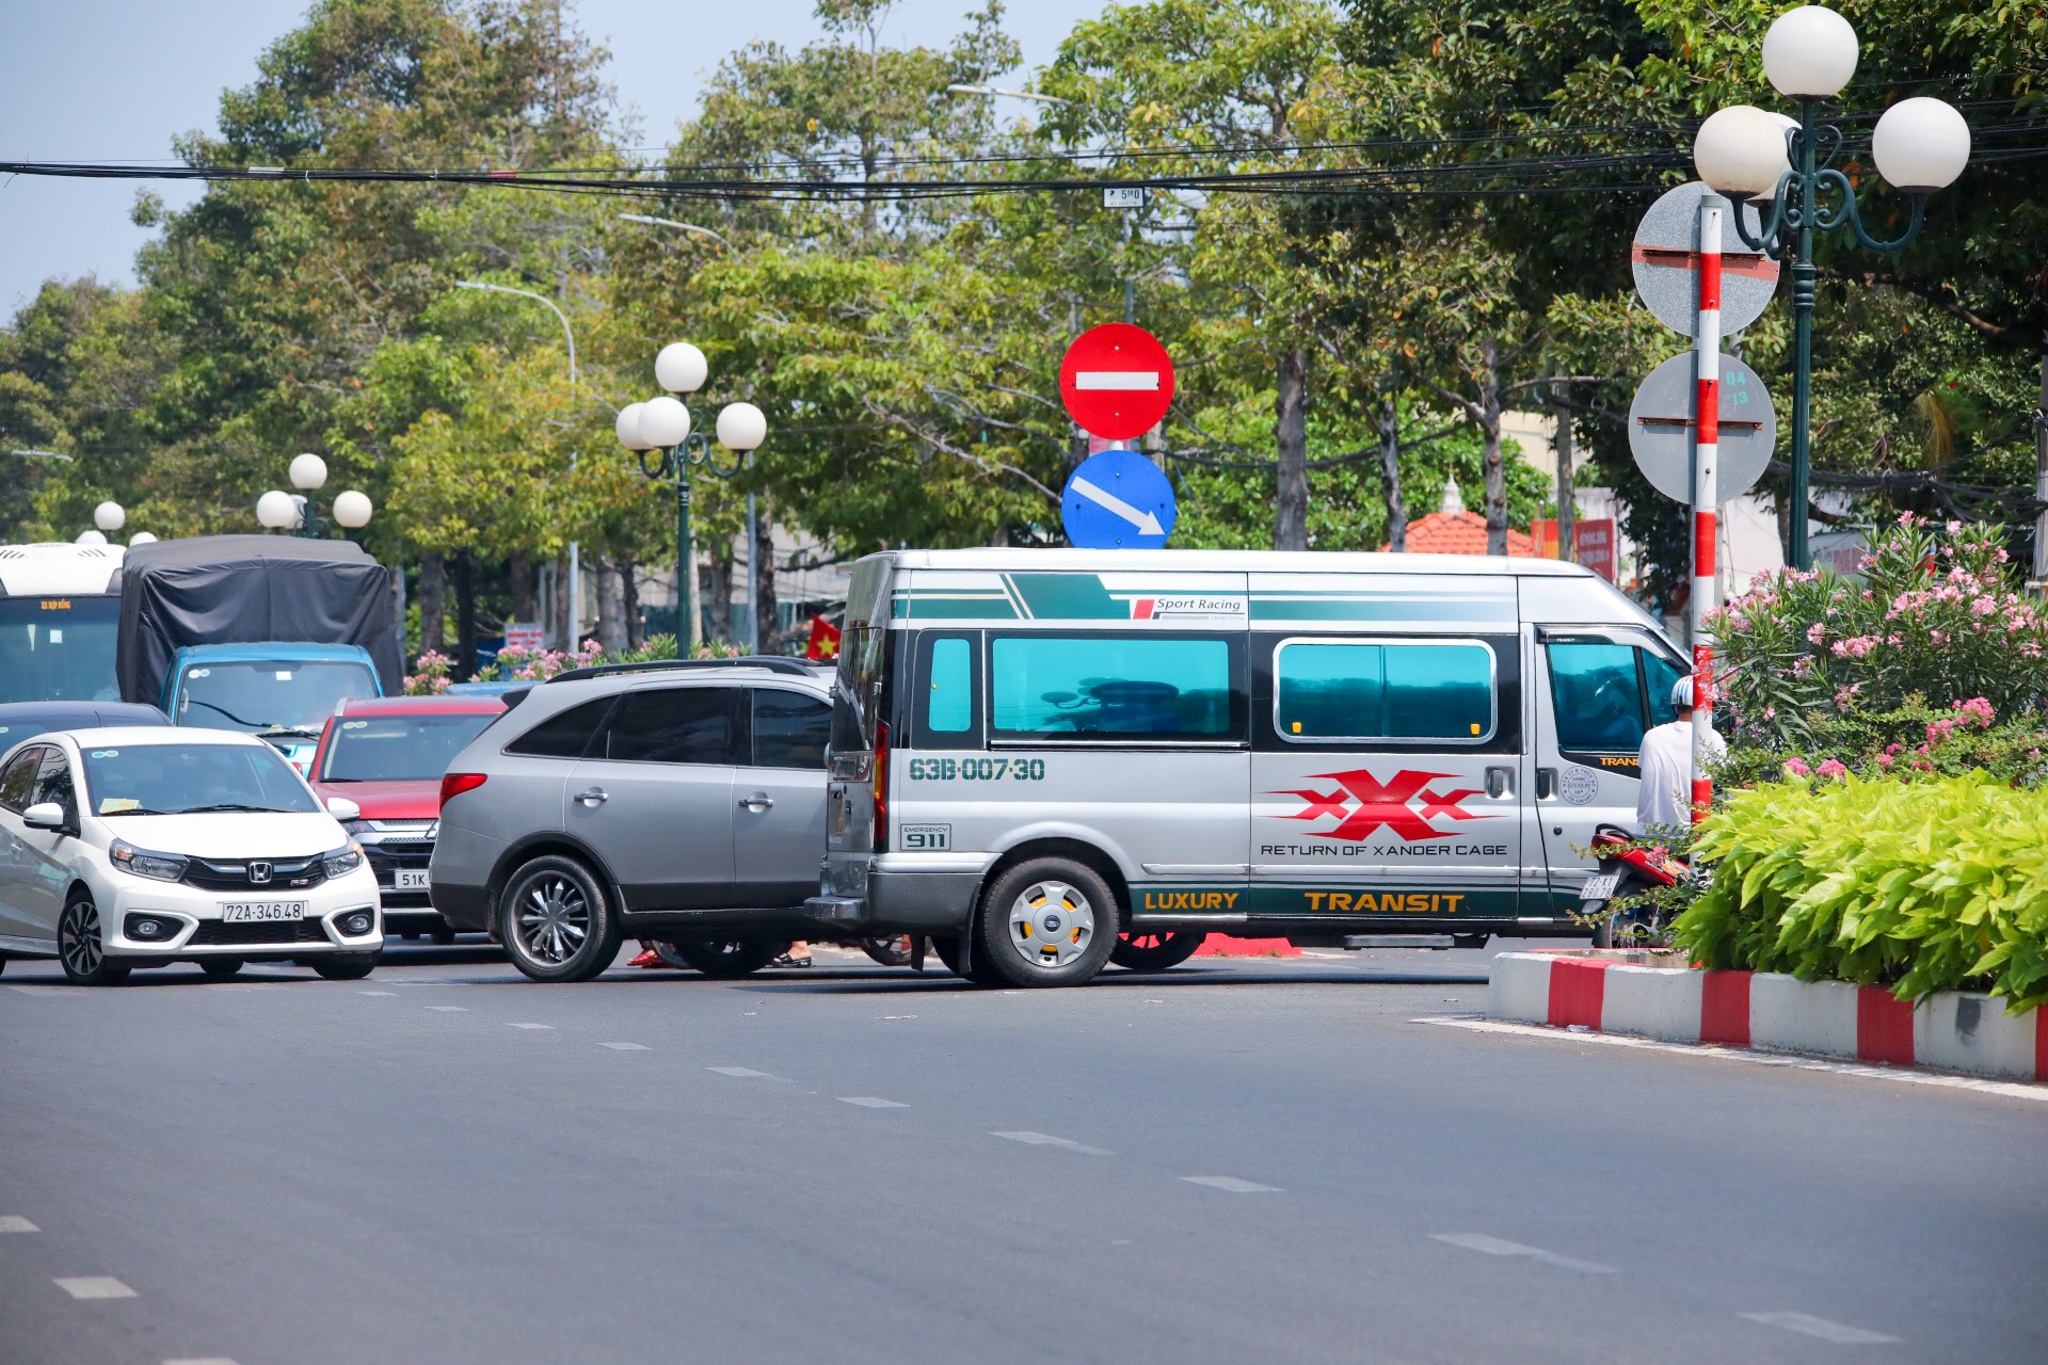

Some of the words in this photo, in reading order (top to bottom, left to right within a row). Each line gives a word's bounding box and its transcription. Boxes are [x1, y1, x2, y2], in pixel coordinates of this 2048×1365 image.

[1157, 598, 1196, 610] Sport
[1198, 599, 1241, 612] Racing
[907, 834, 945, 847] 911
[1261, 845, 1338, 856] RETURN
[1342, 846, 1367, 856] OF
[1373, 845, 1450, 856] XANDER
[1455, 845, 1508, 855] CAGE
[1145, 893, 1239, 909] LUXURY
[1304, 892, 1466, 912] TRANSIT
[226, 904, 300, 920] 72A-346.48
